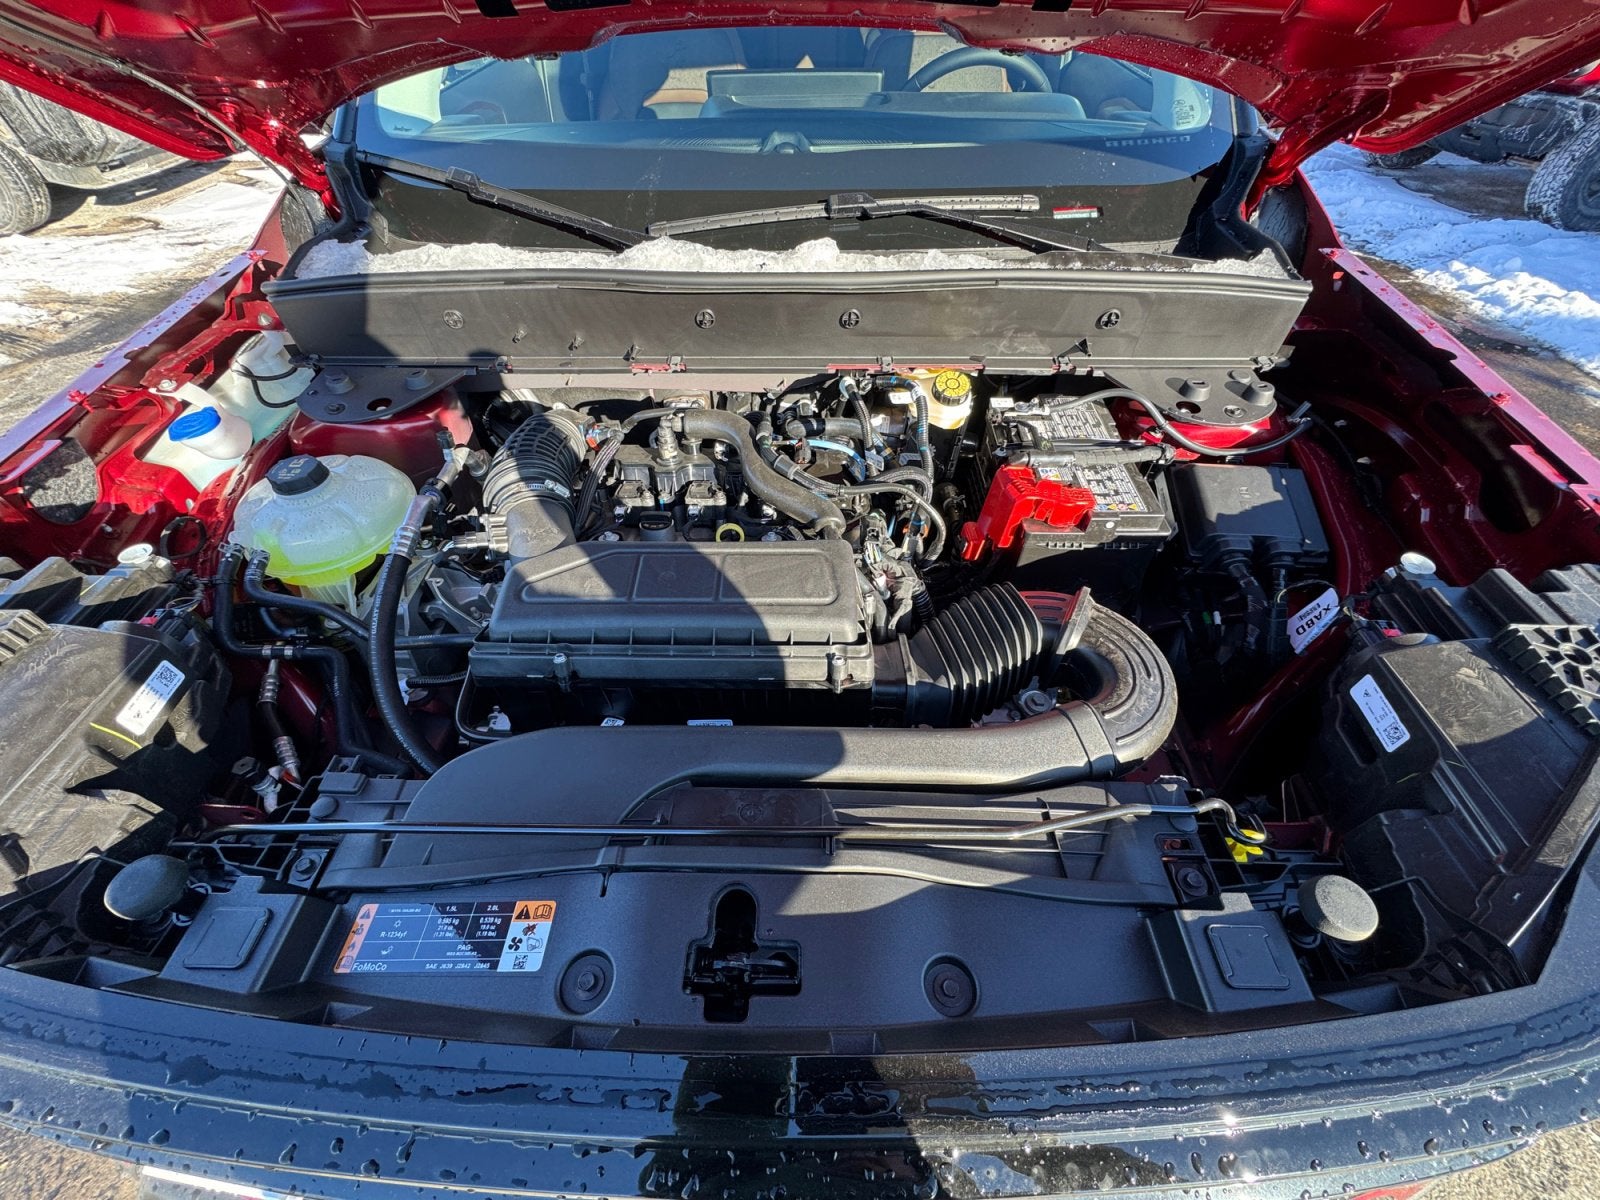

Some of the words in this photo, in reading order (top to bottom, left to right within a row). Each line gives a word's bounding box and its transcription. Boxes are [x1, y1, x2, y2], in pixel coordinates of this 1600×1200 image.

[1104, 135, 1191, 147] BRONCO
[370, 607, 379, 635] GALAXY
[1295, 604, 1331, 635] XABD
[352, 962, 387, 971] FoMoCo
